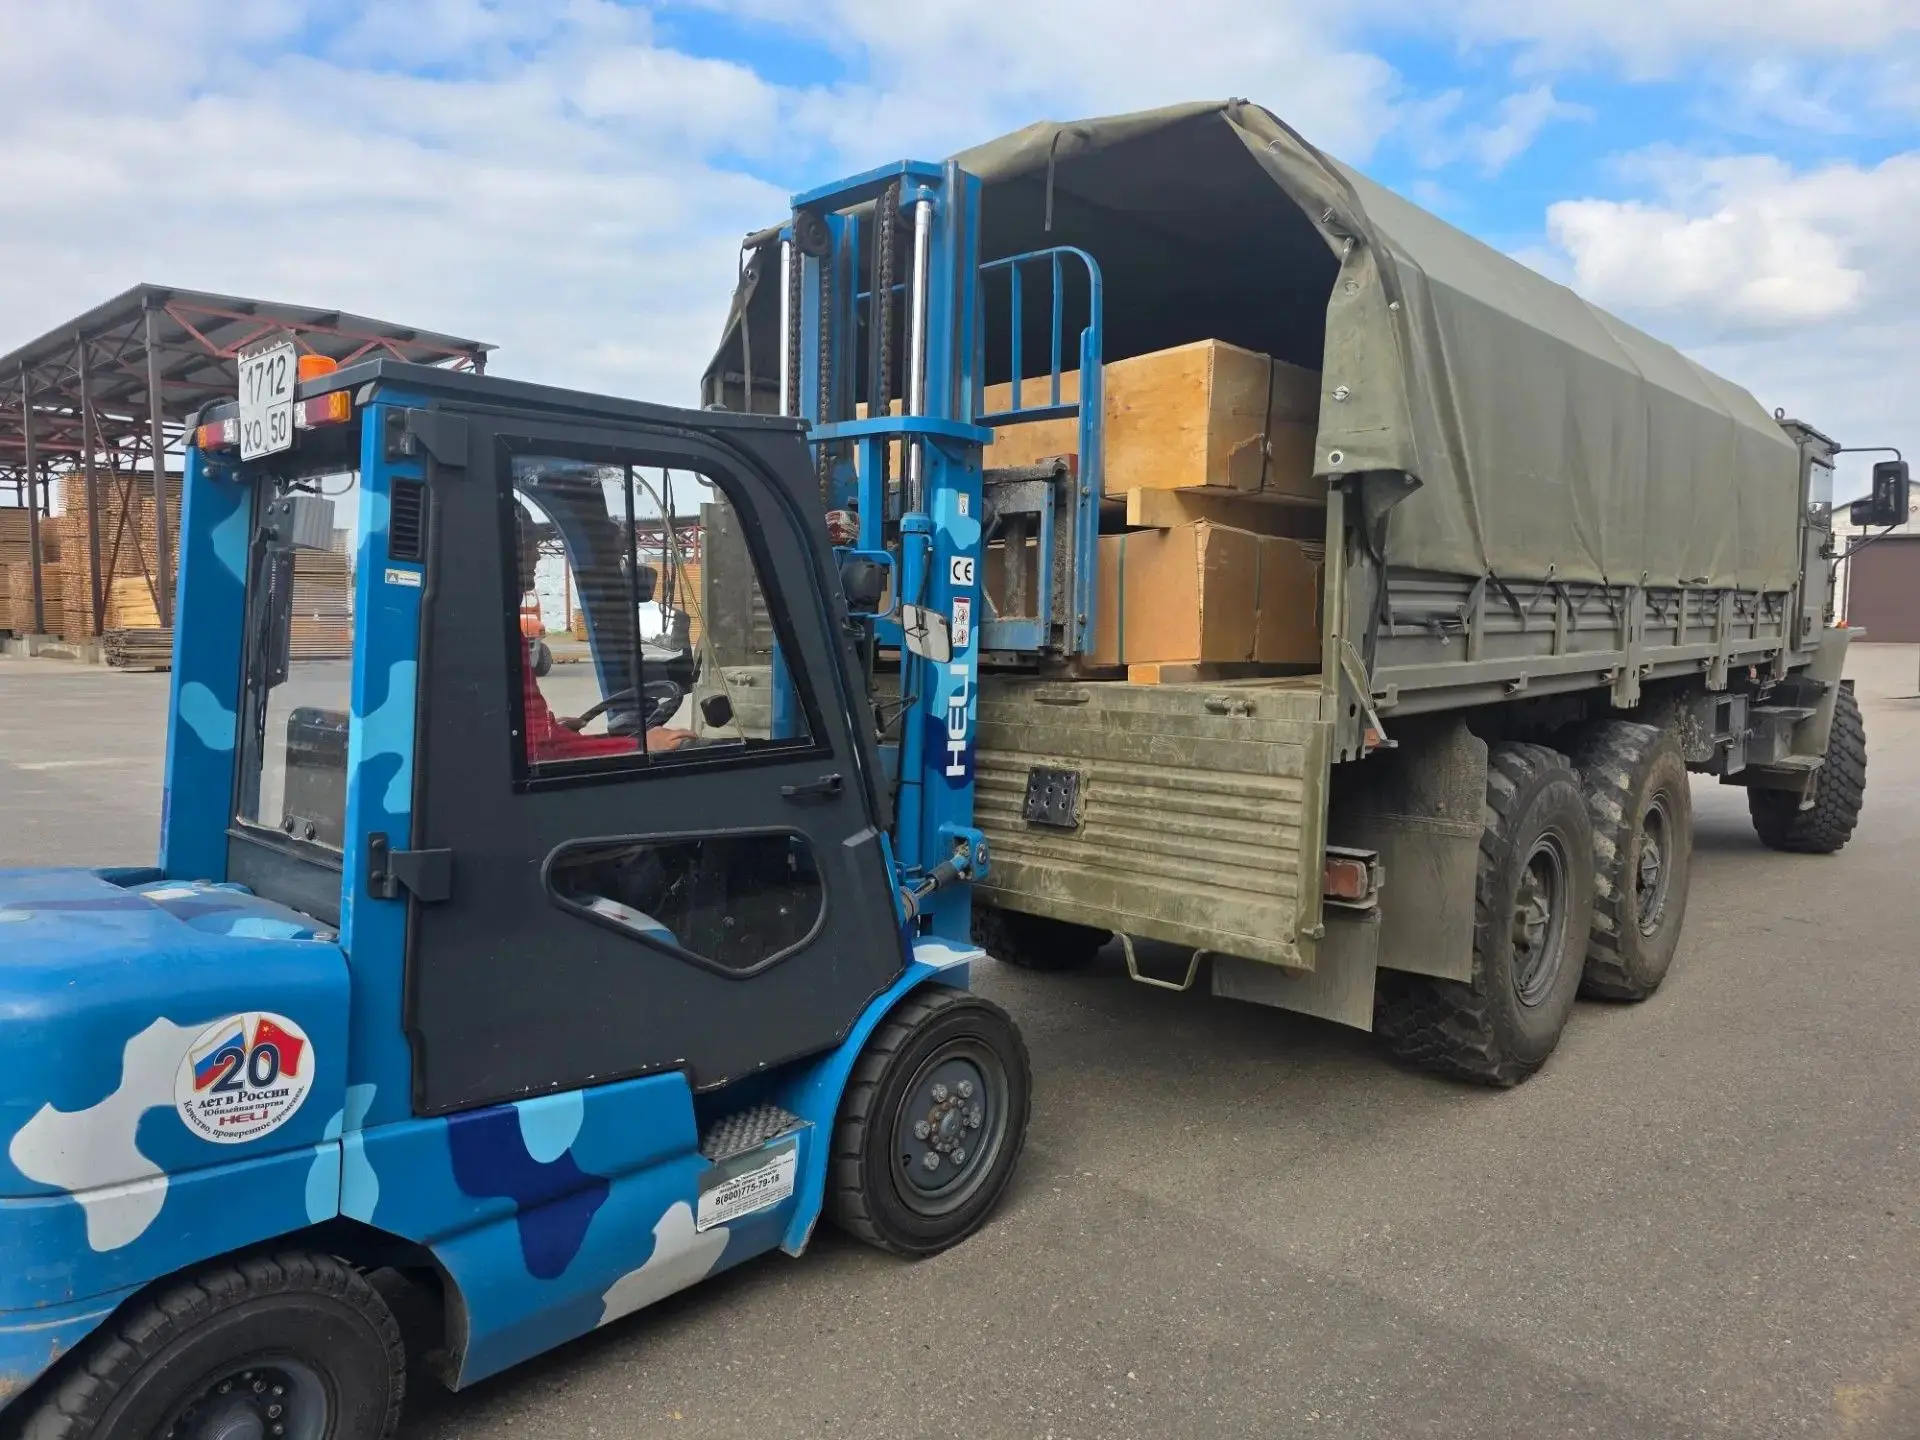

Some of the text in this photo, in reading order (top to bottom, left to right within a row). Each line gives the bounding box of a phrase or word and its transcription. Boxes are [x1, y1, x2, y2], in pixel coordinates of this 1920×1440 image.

[246, 355, 286, 405] 1712
[271, 411, 286, 444] 50
[952, 561, 972, 581] CE
[946, 664, 969, 776] HELI
[210, 1043, 280, 1093] 20
[198, 1088, 290, 1109] лет в России
[204, 1100, 284, 1117] Юбилейная партия
[183, 1100, 212, 1134] Качество,
[212, 1122, 271, 1138] проверенное
[219, 1110, 268, 1126] HELI
